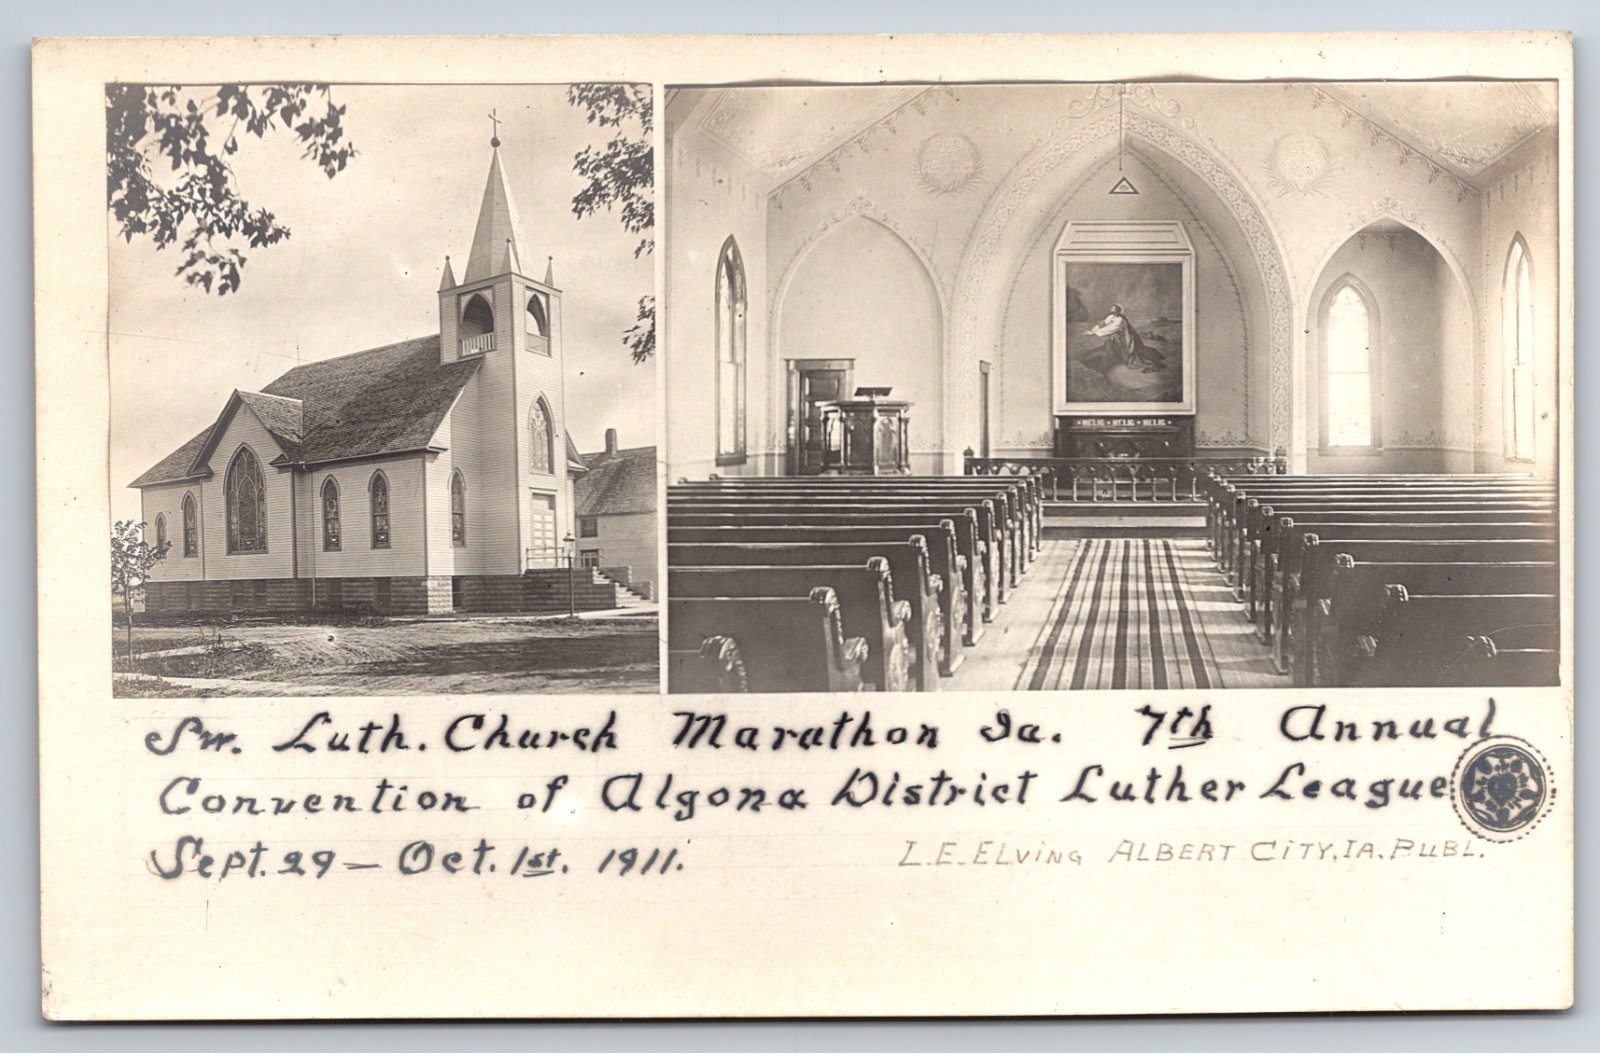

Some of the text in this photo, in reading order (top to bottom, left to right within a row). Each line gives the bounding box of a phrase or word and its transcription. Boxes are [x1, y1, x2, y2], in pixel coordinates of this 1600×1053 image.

[271, 710, 428, 754] Luth.
[444, 709, 619, 754] Church
[671, 710, 940, 751] Marathon
[979, 708, 1062, 745] Ia.
[1135, 704, 1215, 750] 7th
[1278, 696, 1498, 743] Annual
[158, 761, 1449, 821] Convention of Algona District Luther League
[145, 835, 269, 882] Sept.
[398, 837, 497, 876] Oct.
[598, 846, 685, 876] 1911.
[1107, 838, 1237, 863] ALBERT
